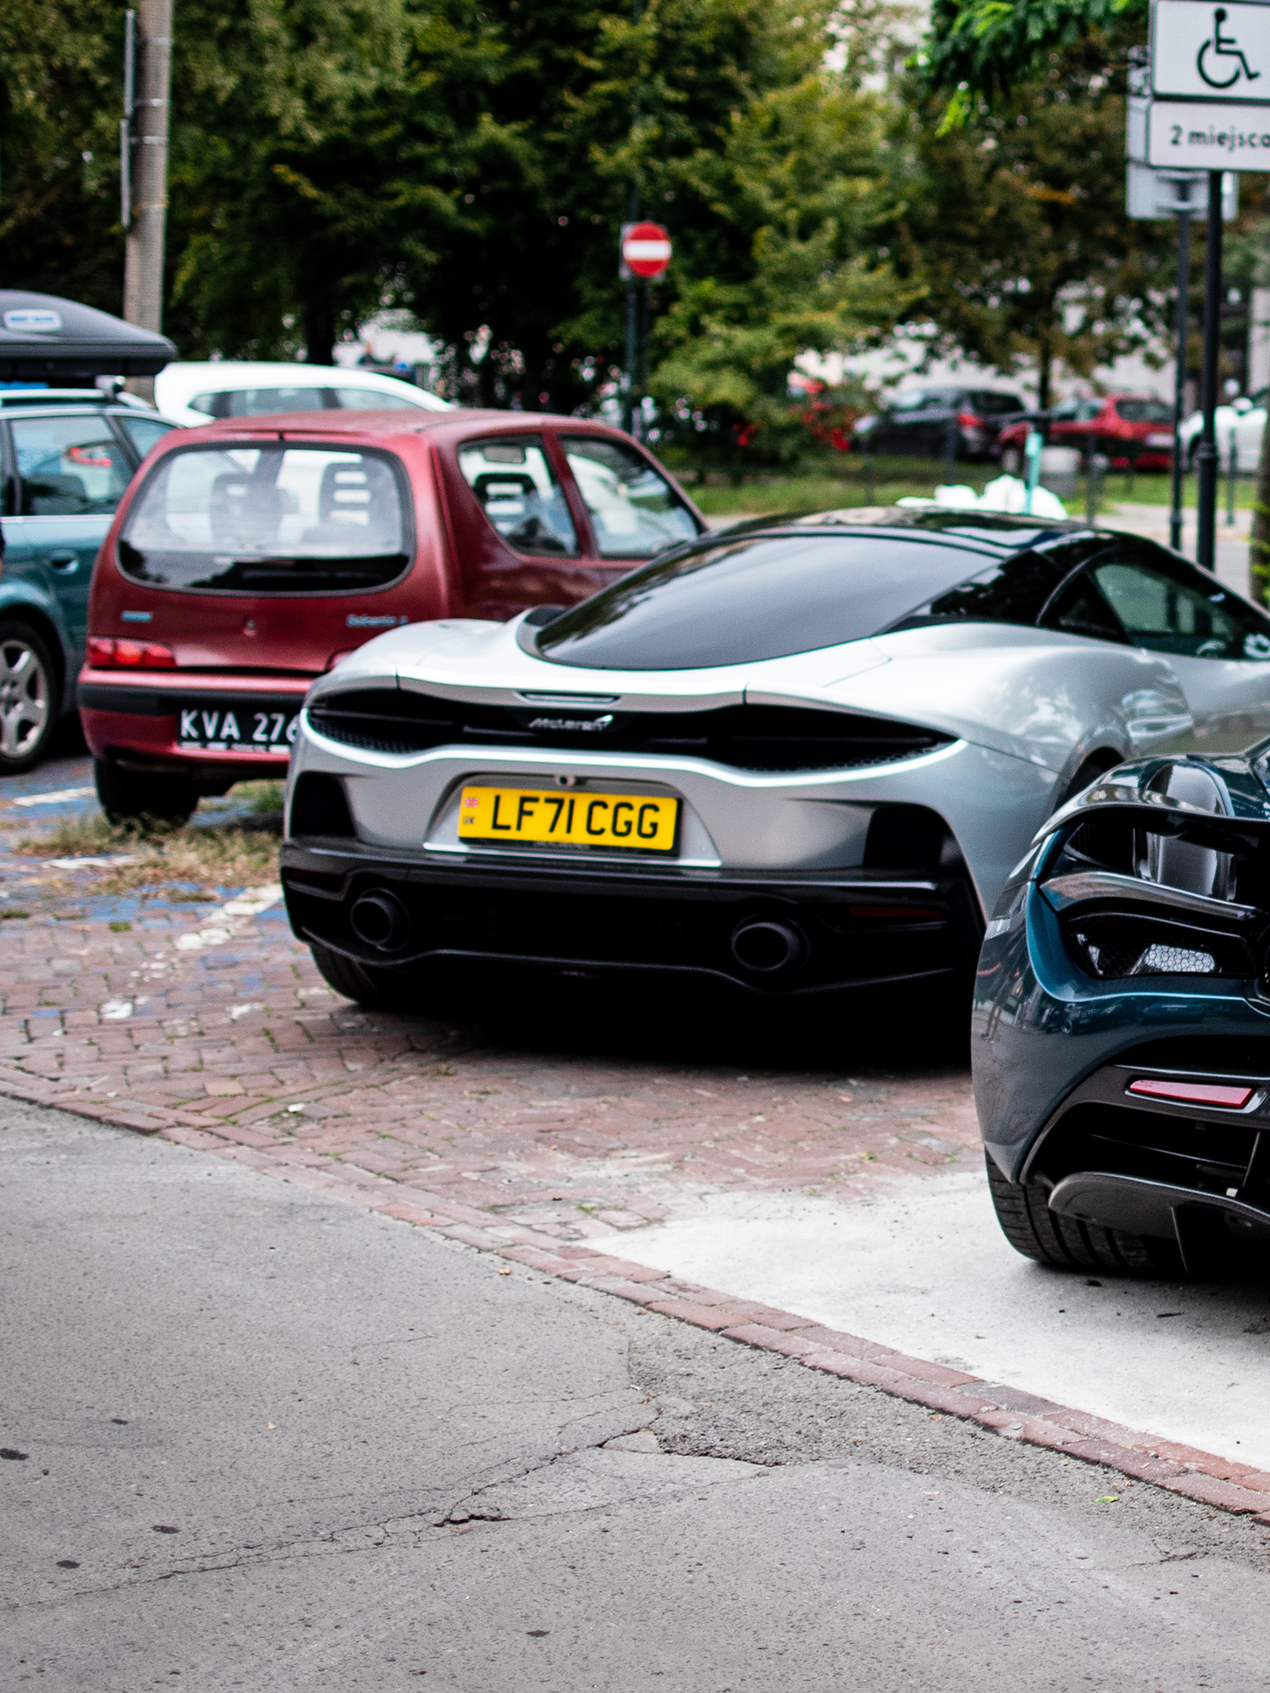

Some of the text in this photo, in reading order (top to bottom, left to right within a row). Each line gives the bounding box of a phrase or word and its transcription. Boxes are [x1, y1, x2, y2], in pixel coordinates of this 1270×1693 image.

[1170, 124, 1183, 146] 2
[180, 709, 241, 740] KVA
[490, 794, 661, 840] LF71 CGG
